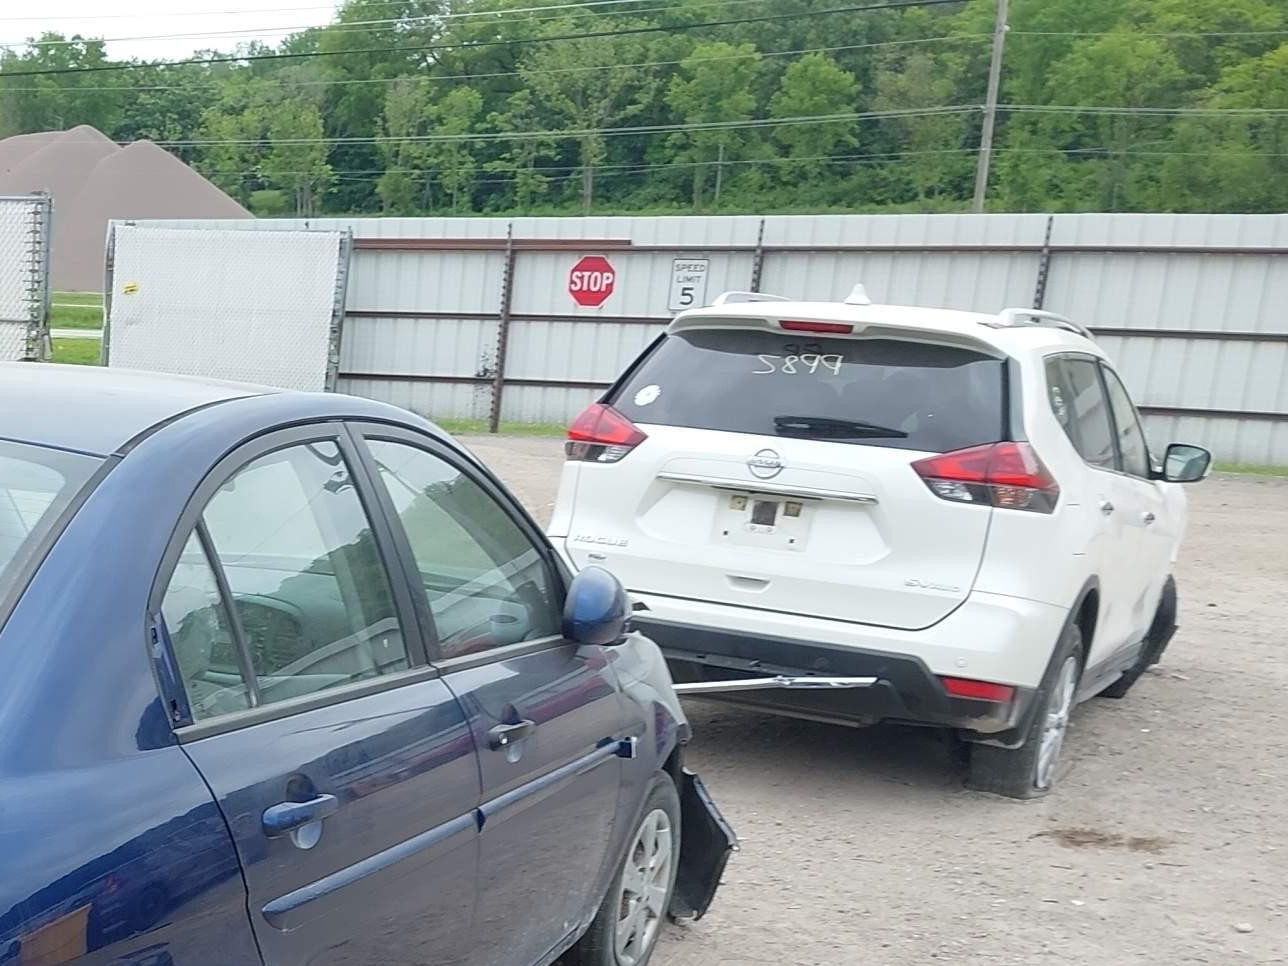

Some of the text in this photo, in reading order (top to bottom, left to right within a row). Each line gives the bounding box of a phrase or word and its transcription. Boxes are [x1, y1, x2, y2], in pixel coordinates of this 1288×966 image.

[675, 263, 705, 272] SPEED
[570, 271, 613, 292] STOP
[676, 275, 702, 284] LIMIT
[679, 287, 694, 306] 5
[751, 353, 844, 376] 5899
[573, 534, 629, 548] ROGUE
